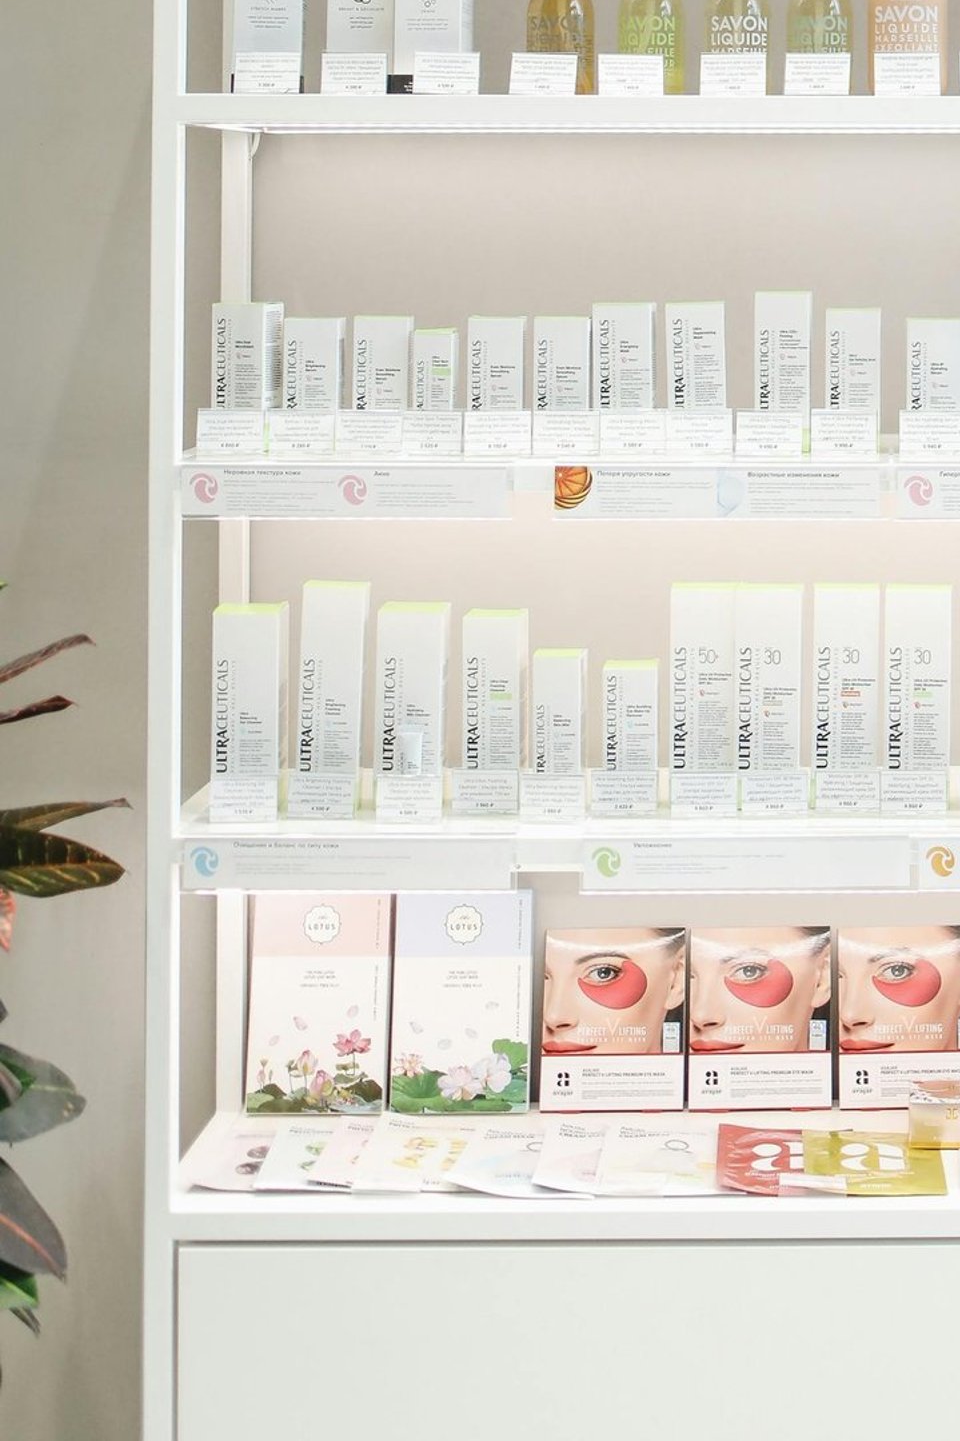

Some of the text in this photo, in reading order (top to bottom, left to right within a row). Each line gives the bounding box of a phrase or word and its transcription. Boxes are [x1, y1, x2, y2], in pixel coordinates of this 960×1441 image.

[711, 15, 768, 32] SAVON
[711, 32, 768, 46] LIQUIDE
[874, 5, 938, 23] SAVON
[874, 23, 938, 34] LIQUIDE
[874, 34, 938, 43] MARSEILLE
[287, 340, 297, 409] RACEUTICALS
[356, 339, 367, 409] RACEUTICALS
[471, 340, 481, 411] RACEUTICALS
[537, 339, 548, 410] RACEUTICALS
[911, 341, 921, 411] RACEUTICALS
[763, 649, 781, 665] 30
[842, 649, 860, 664] 30
[914, 649, 932, 664] 30
[216, 659, 229, 773] ULTRACEUTICALS
[300, 658, 315, 772] ULTRACEUTICALS
[382, 657, 396, 771] ULTRACEUTICALS
[536, 704, 545, 773] TRACEUTICALS
[673, 647, 687, 769] ULTRACEUTICALS
[738, 647, 752, 770] ULTRACEUTICALS
[816, 646, 831, 769] ULTRACEUTICALS
[889, 647, 903, 770] ULTRACEUTICALS
[618, 1026, 647, 1036] LIFTING
[766, 1024, 795, 1034] LIFTING
[915, 1023, 943, 1033] LIFTING
